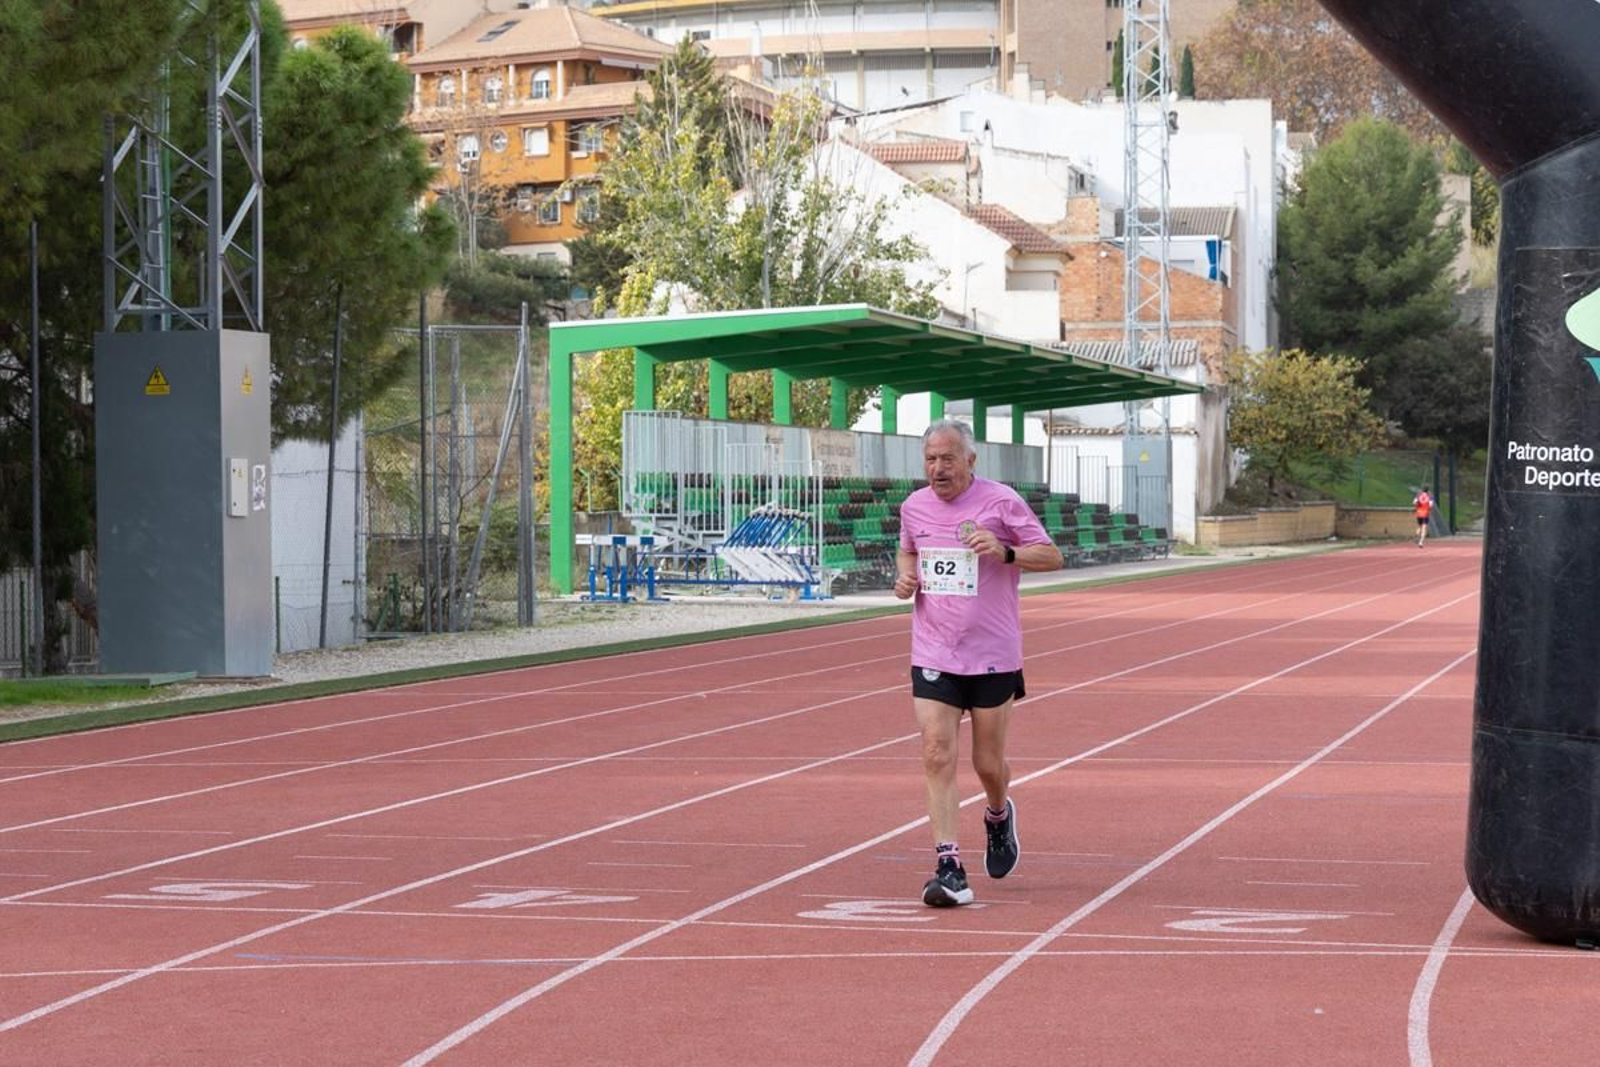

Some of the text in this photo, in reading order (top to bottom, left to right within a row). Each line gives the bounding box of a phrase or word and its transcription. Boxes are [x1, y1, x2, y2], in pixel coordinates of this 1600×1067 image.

[1507, 441, 1594, 462] Patronato
[934, 561, 956, 576] 62
[450, 889, 640, 908] 4
